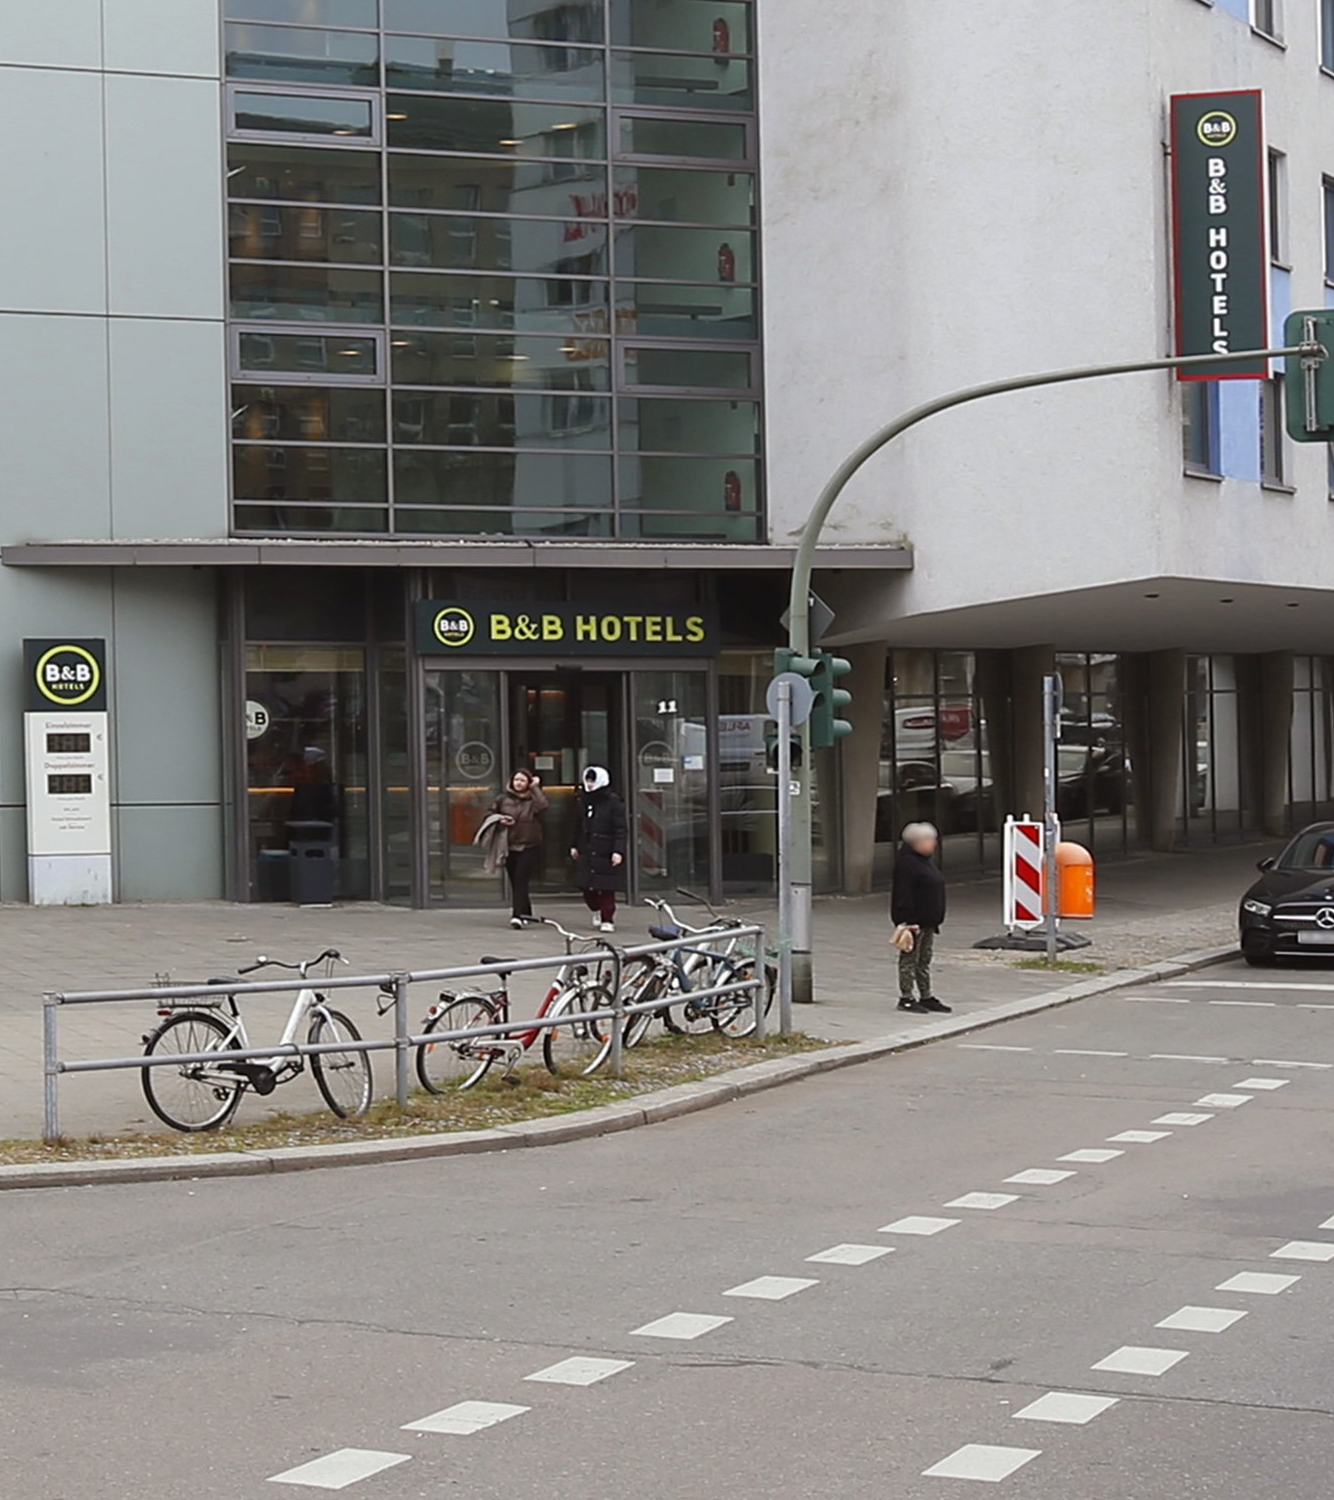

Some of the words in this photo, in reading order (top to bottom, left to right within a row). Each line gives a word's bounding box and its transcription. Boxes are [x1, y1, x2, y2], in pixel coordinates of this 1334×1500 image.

[1203, 121, 1231, 134] B&B
[1208, 158, 1228, 214] B&B
[1208, 227, 1230, 355] HOTELS
[440, 619, 469, 632] B&B
[490, 614, 564, 640] B&B
[576, 615, 705, 642] HOTELS
[45, 664, 91, 682] B&B
[657, 700, 677, 713] 11
